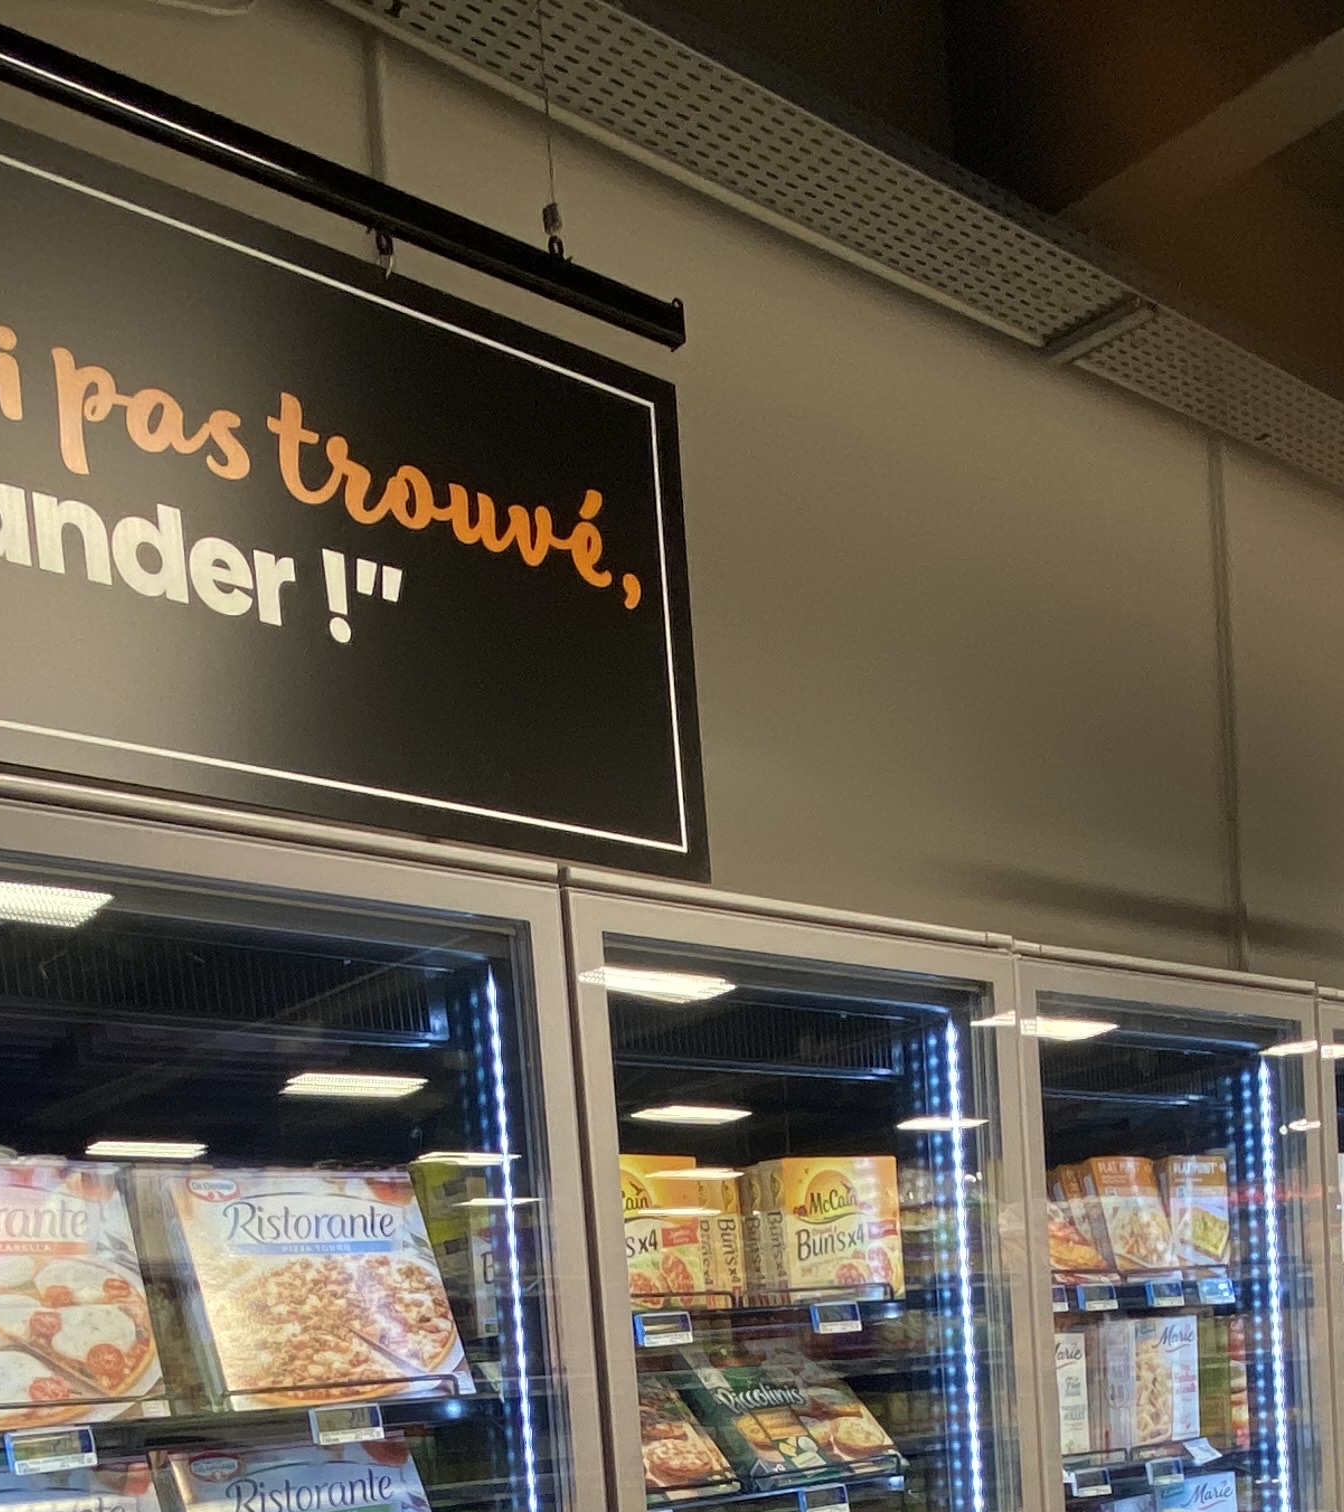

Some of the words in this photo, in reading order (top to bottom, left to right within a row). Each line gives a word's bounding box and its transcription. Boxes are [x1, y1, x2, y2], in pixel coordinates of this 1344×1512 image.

[50, 347, 251, 482] pas
[267, 392, 642, 612] trouvé,
[808, 1187, 858, 1216] McCain
[221, 1199, 397, 1245] Ristorante
[1156, 1326, 1196, 1349] Marie
[714, 1381, 806, 1415] Piccolinis
[1181, 1484, 1234, 1509] Marie
